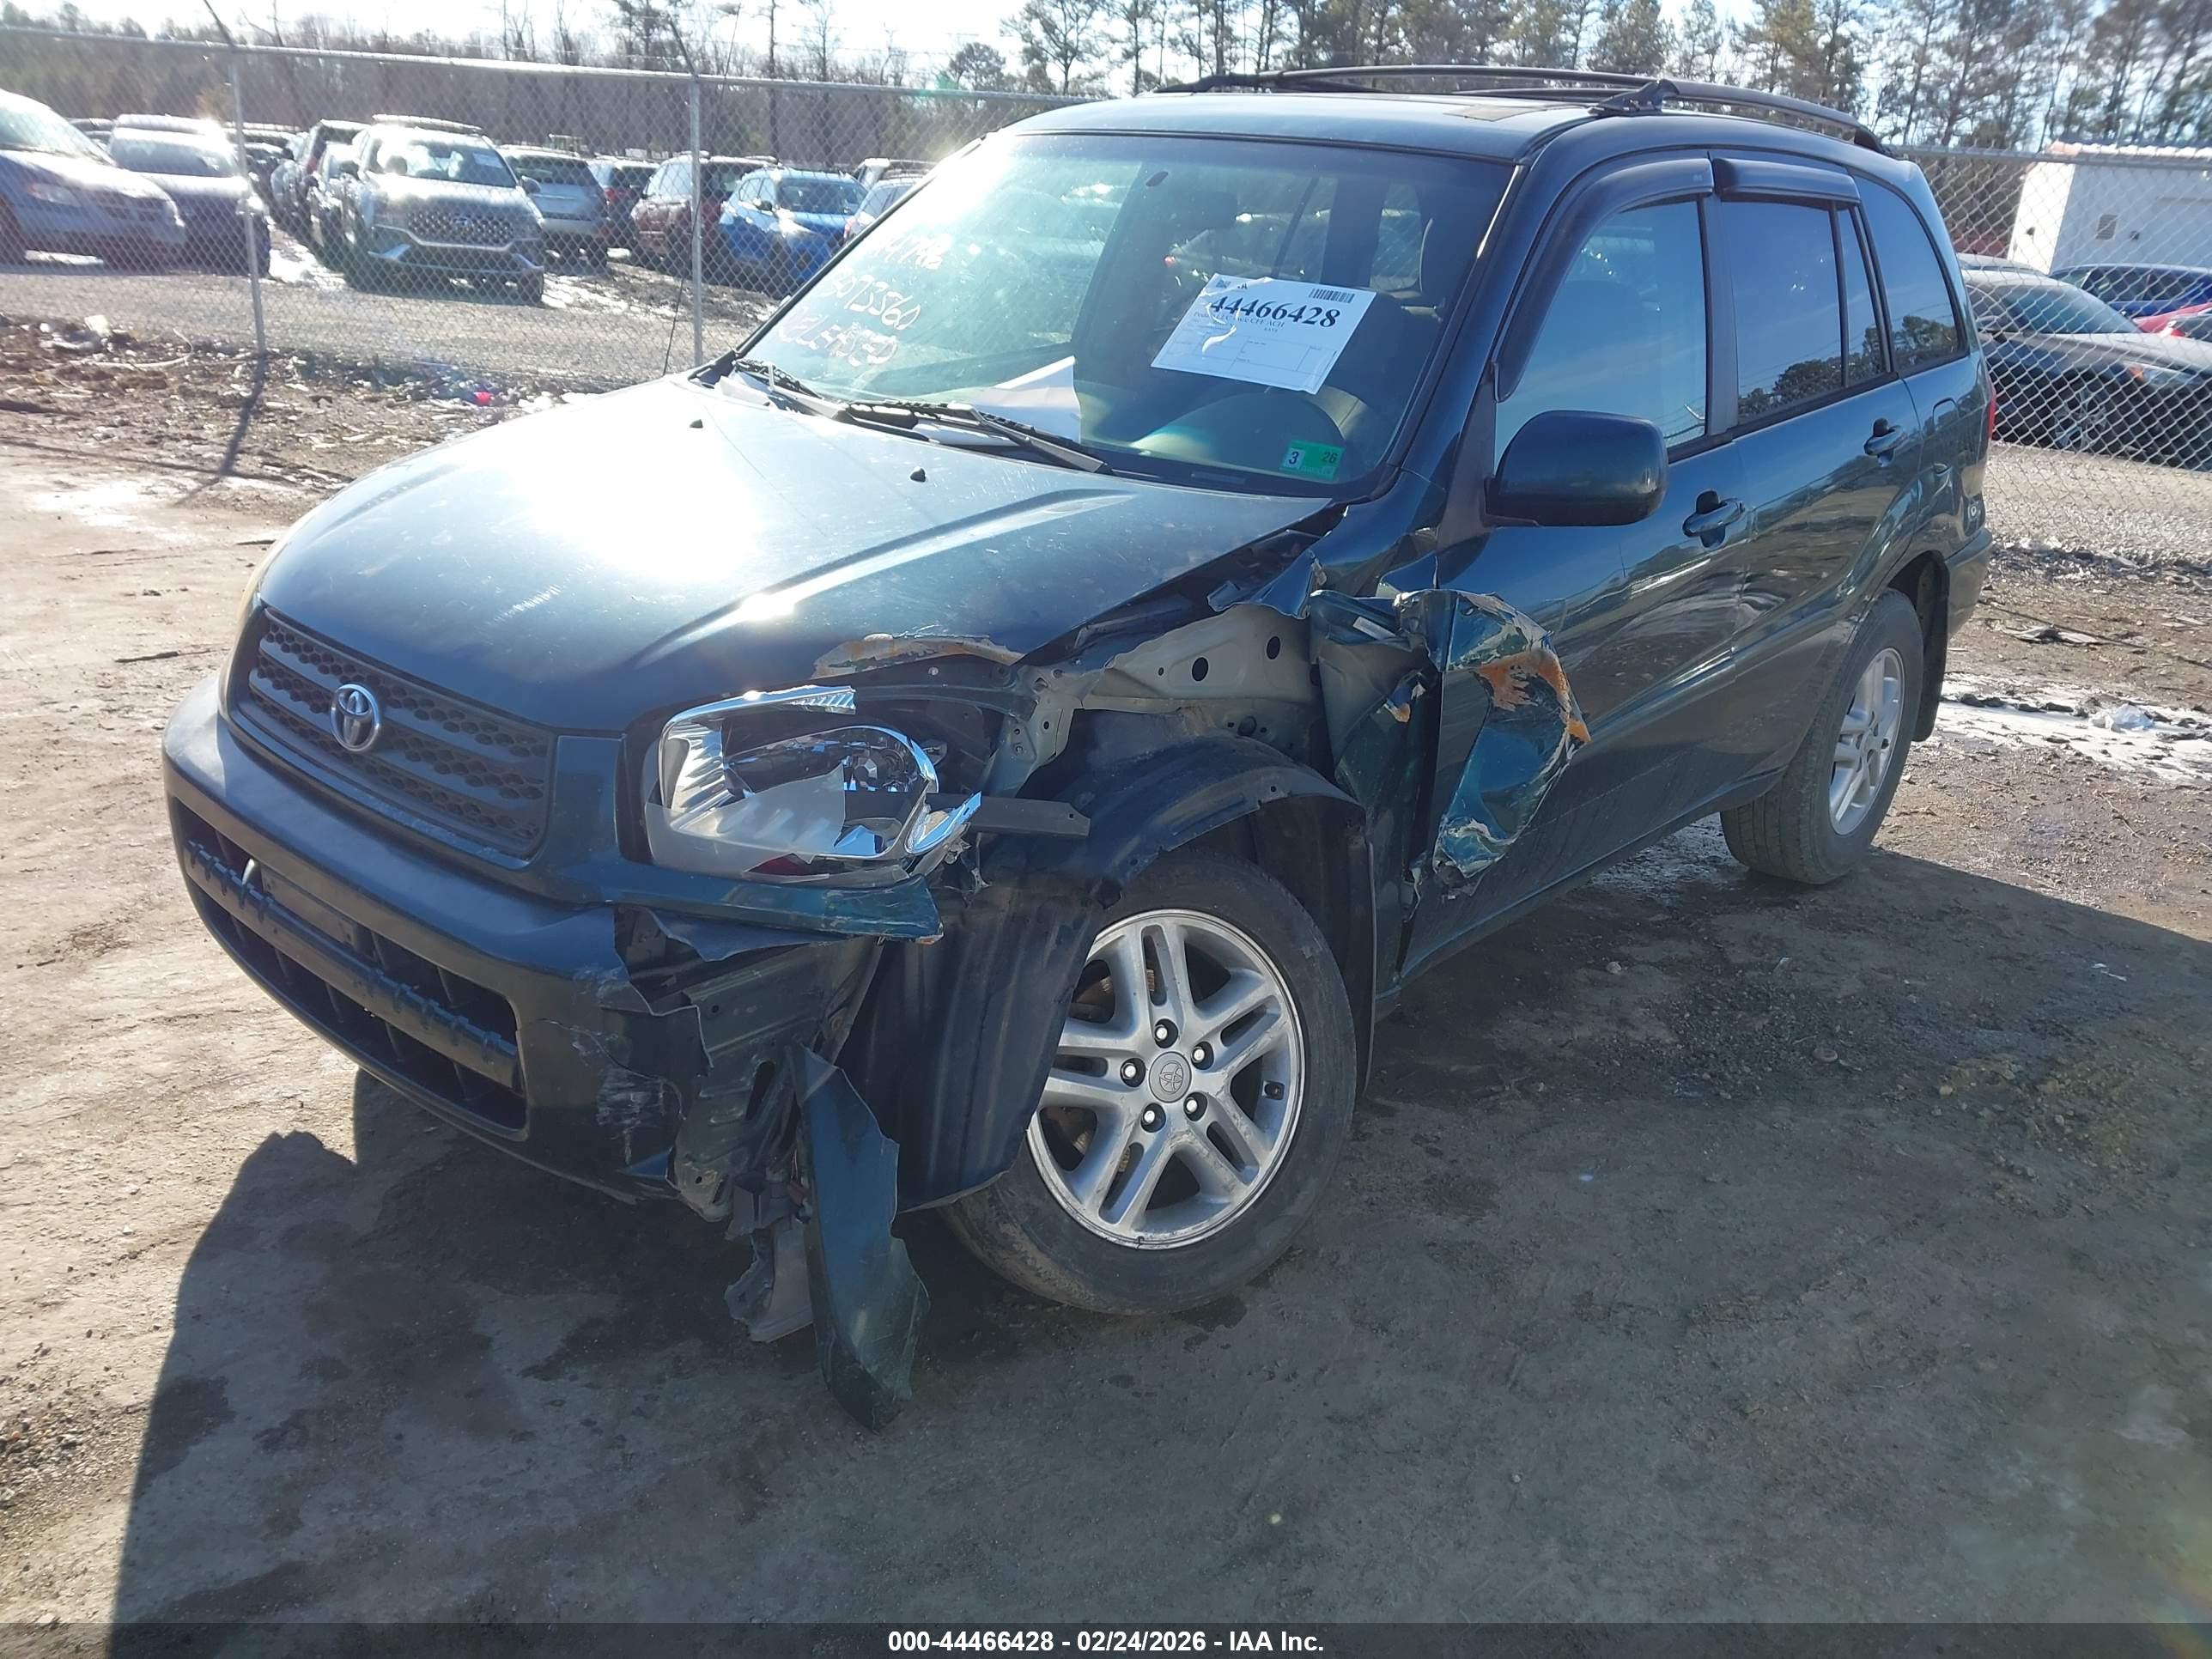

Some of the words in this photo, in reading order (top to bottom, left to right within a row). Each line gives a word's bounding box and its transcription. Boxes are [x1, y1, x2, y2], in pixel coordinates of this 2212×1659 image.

[1209, 295, 1341, 328] 44466428
[1288, 451, 1300, 465] 3
[1321, 451, 1339, 464] 26
